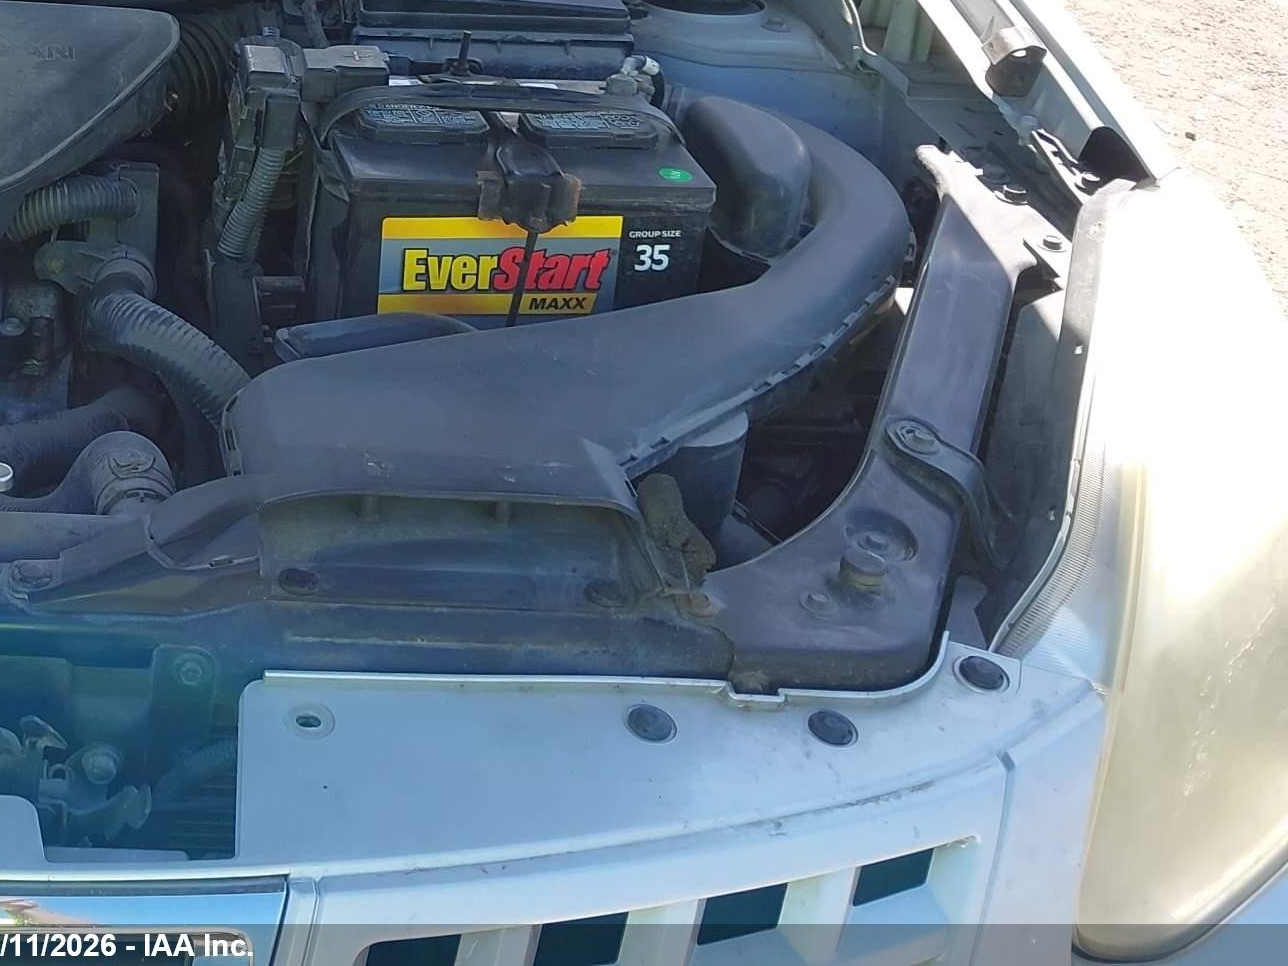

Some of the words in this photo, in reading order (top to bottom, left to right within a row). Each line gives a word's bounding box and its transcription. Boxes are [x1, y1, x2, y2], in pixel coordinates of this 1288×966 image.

[628, 231, 661, 239] GROUP
[662, 229, 682, 238] SIZE
[634, 244, 671, 271] 35
[402, 246, 611, 291] EverStart
[528, 297, 587, 311] MAXX
